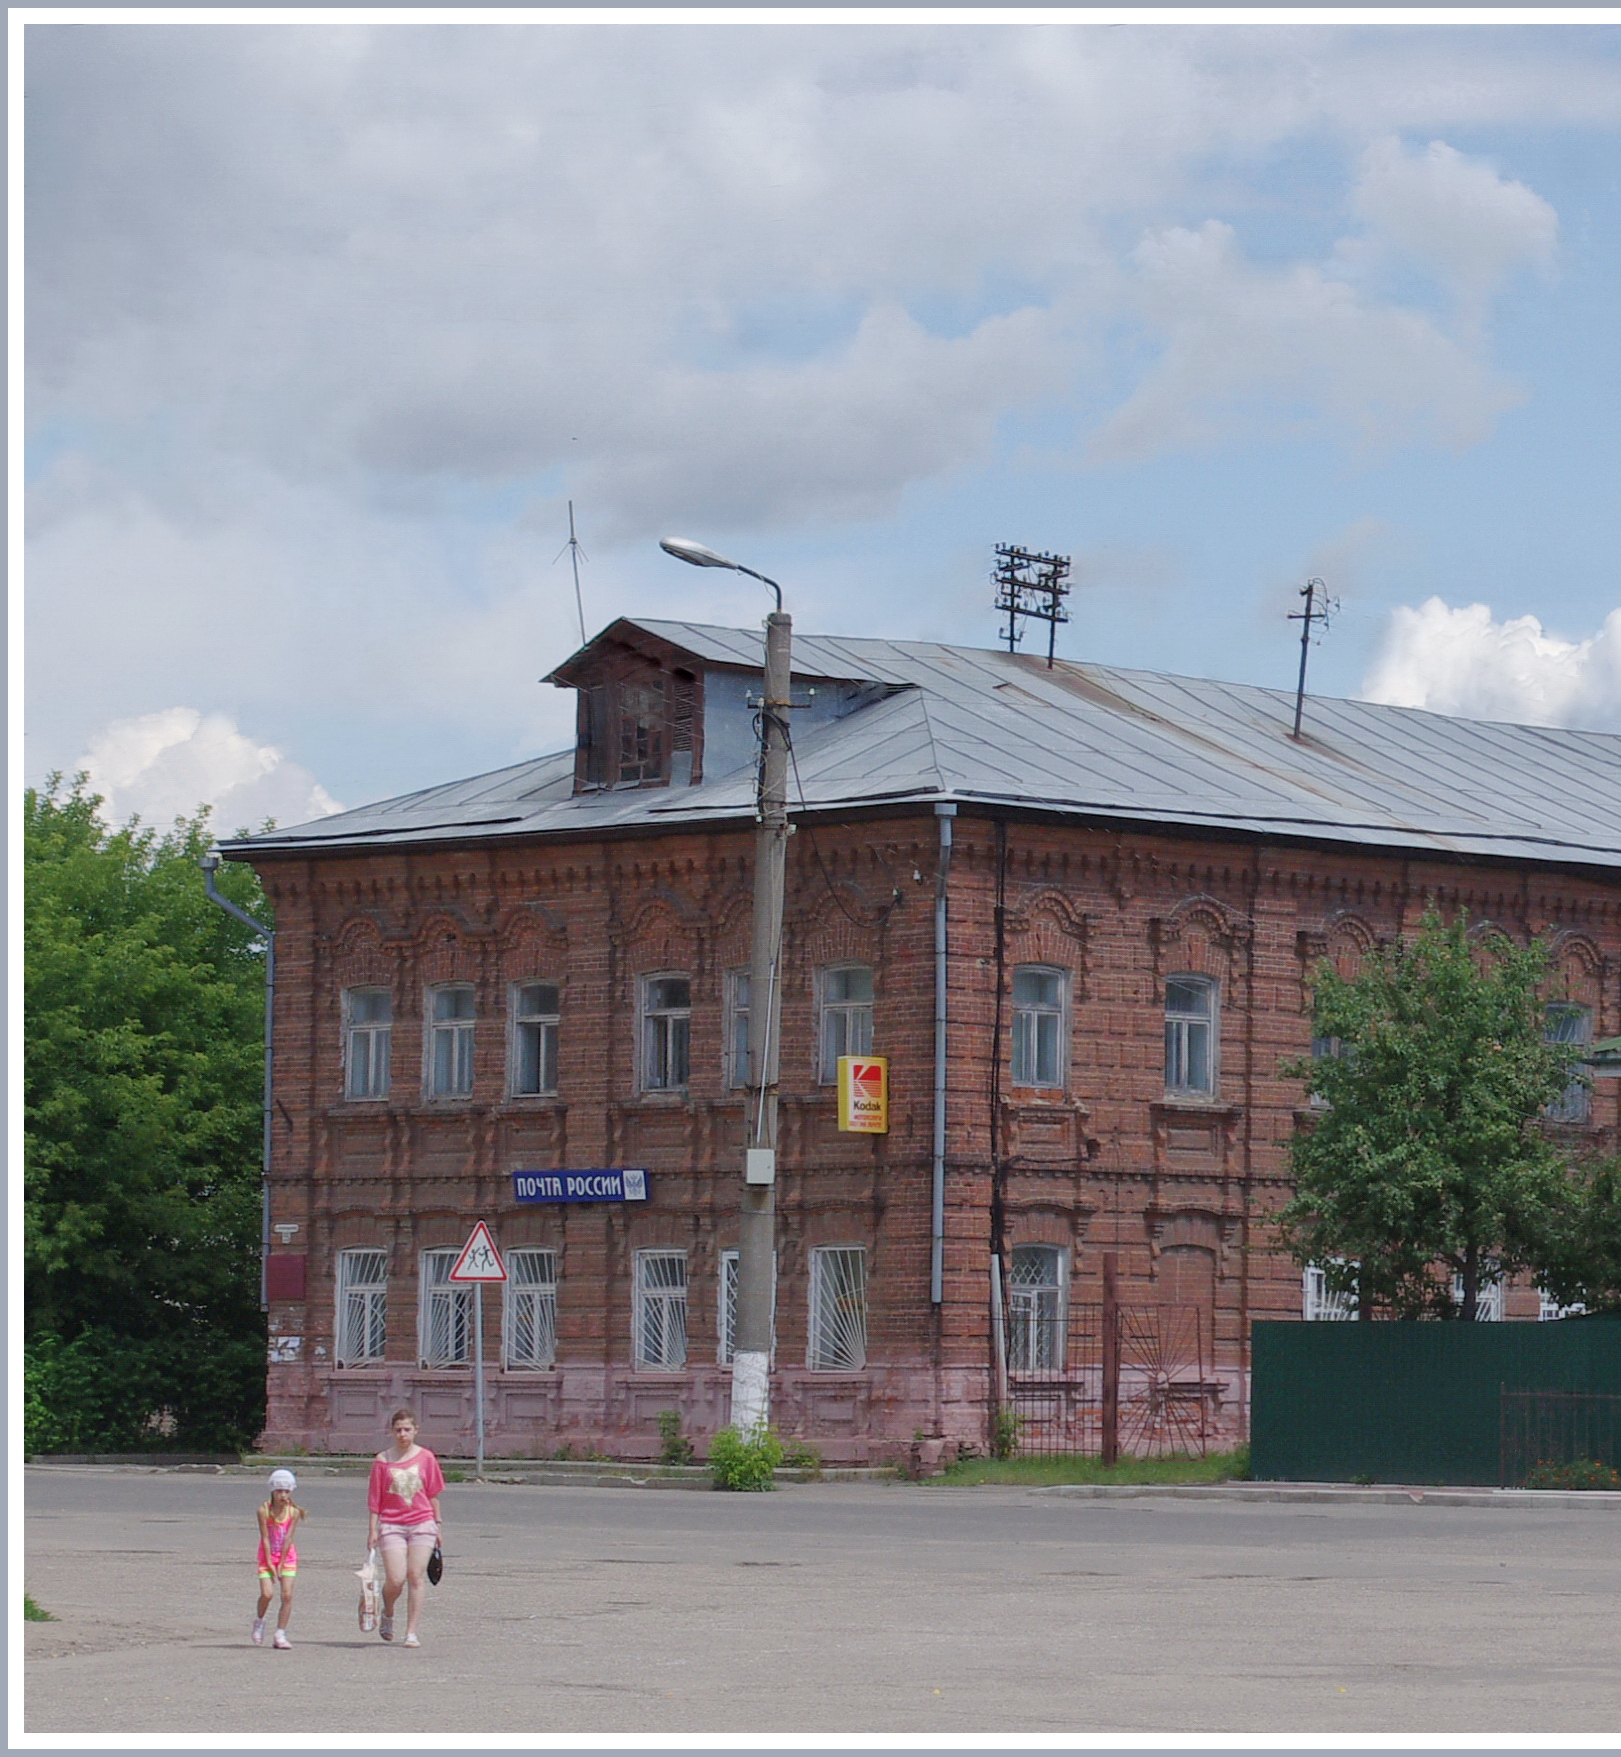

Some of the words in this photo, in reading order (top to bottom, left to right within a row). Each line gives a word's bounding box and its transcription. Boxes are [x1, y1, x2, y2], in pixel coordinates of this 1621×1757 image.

[854, 1101, 881, 1111] Kodak
[517, 1177, 562, 1196] ПОЧТА
[567, 1176, 621, 1196] РОССИИ
